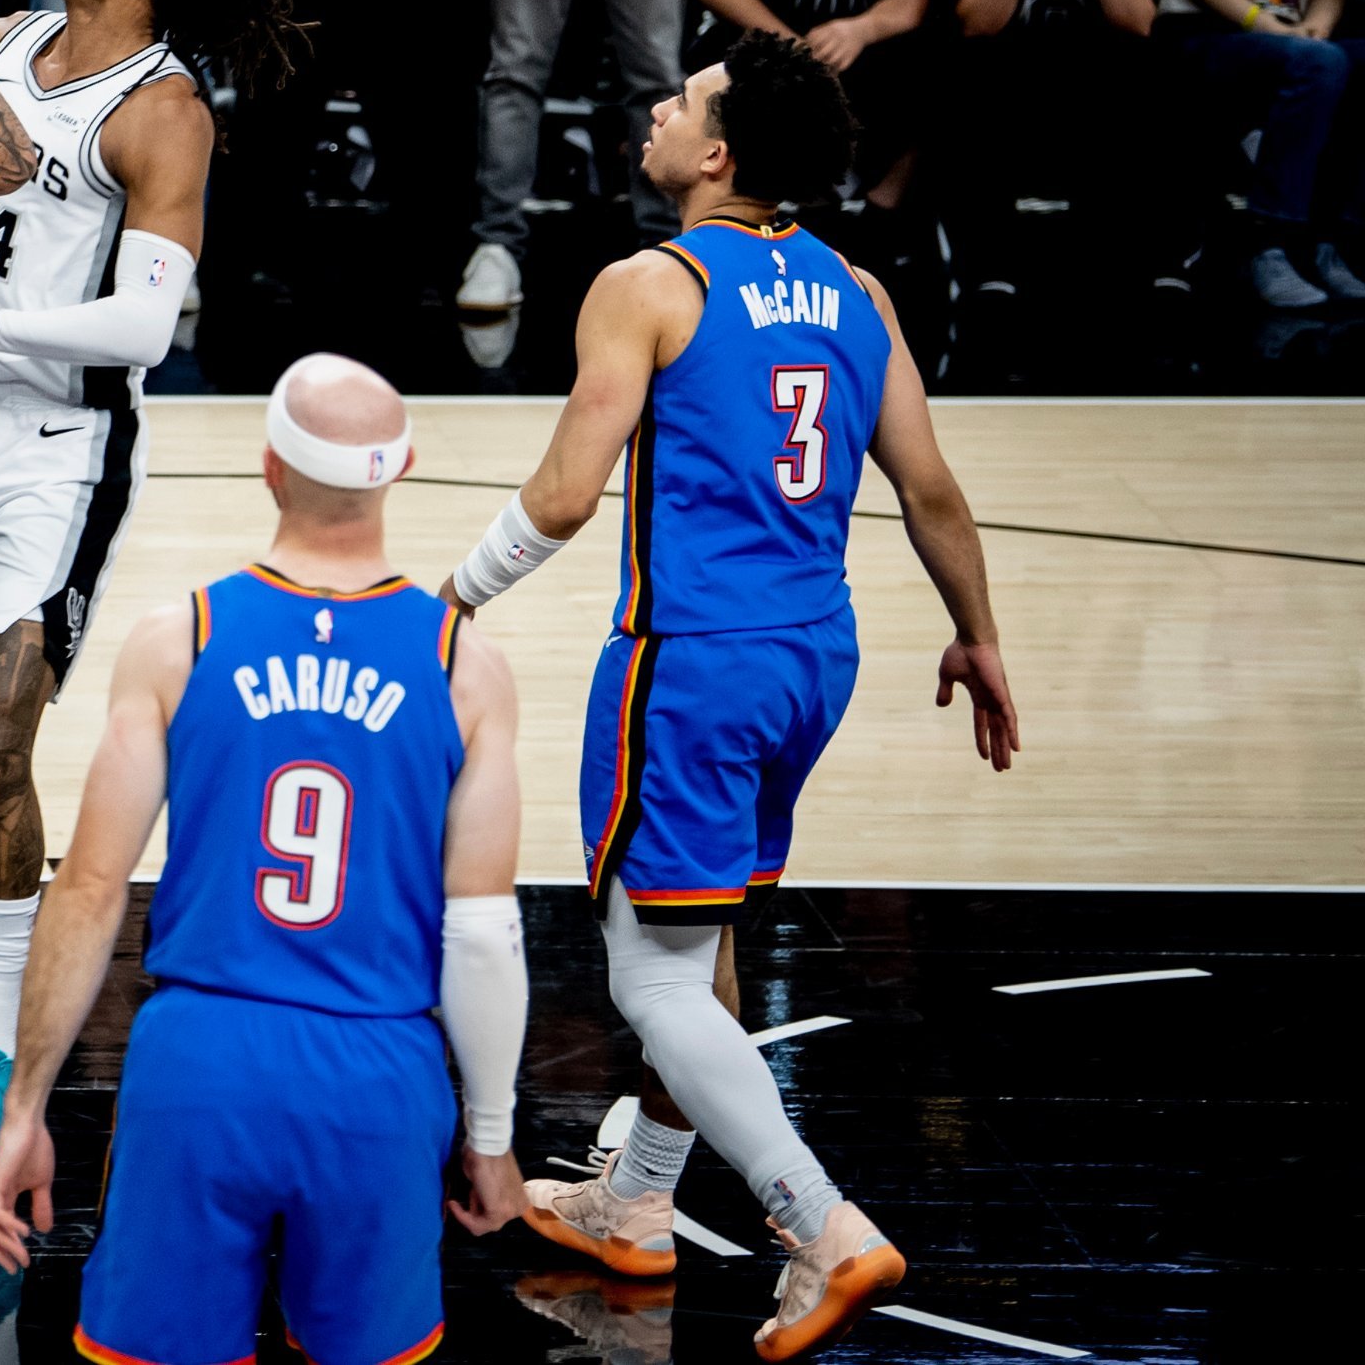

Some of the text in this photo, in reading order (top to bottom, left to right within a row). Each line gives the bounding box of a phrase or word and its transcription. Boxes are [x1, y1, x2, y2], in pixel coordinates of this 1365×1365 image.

[738, 279, 840, 331] McCAIN
[771, 364, 830, 505] 3
[233, 654, 407, 733] CARUSO
[254, 760, 354, 931] 9
